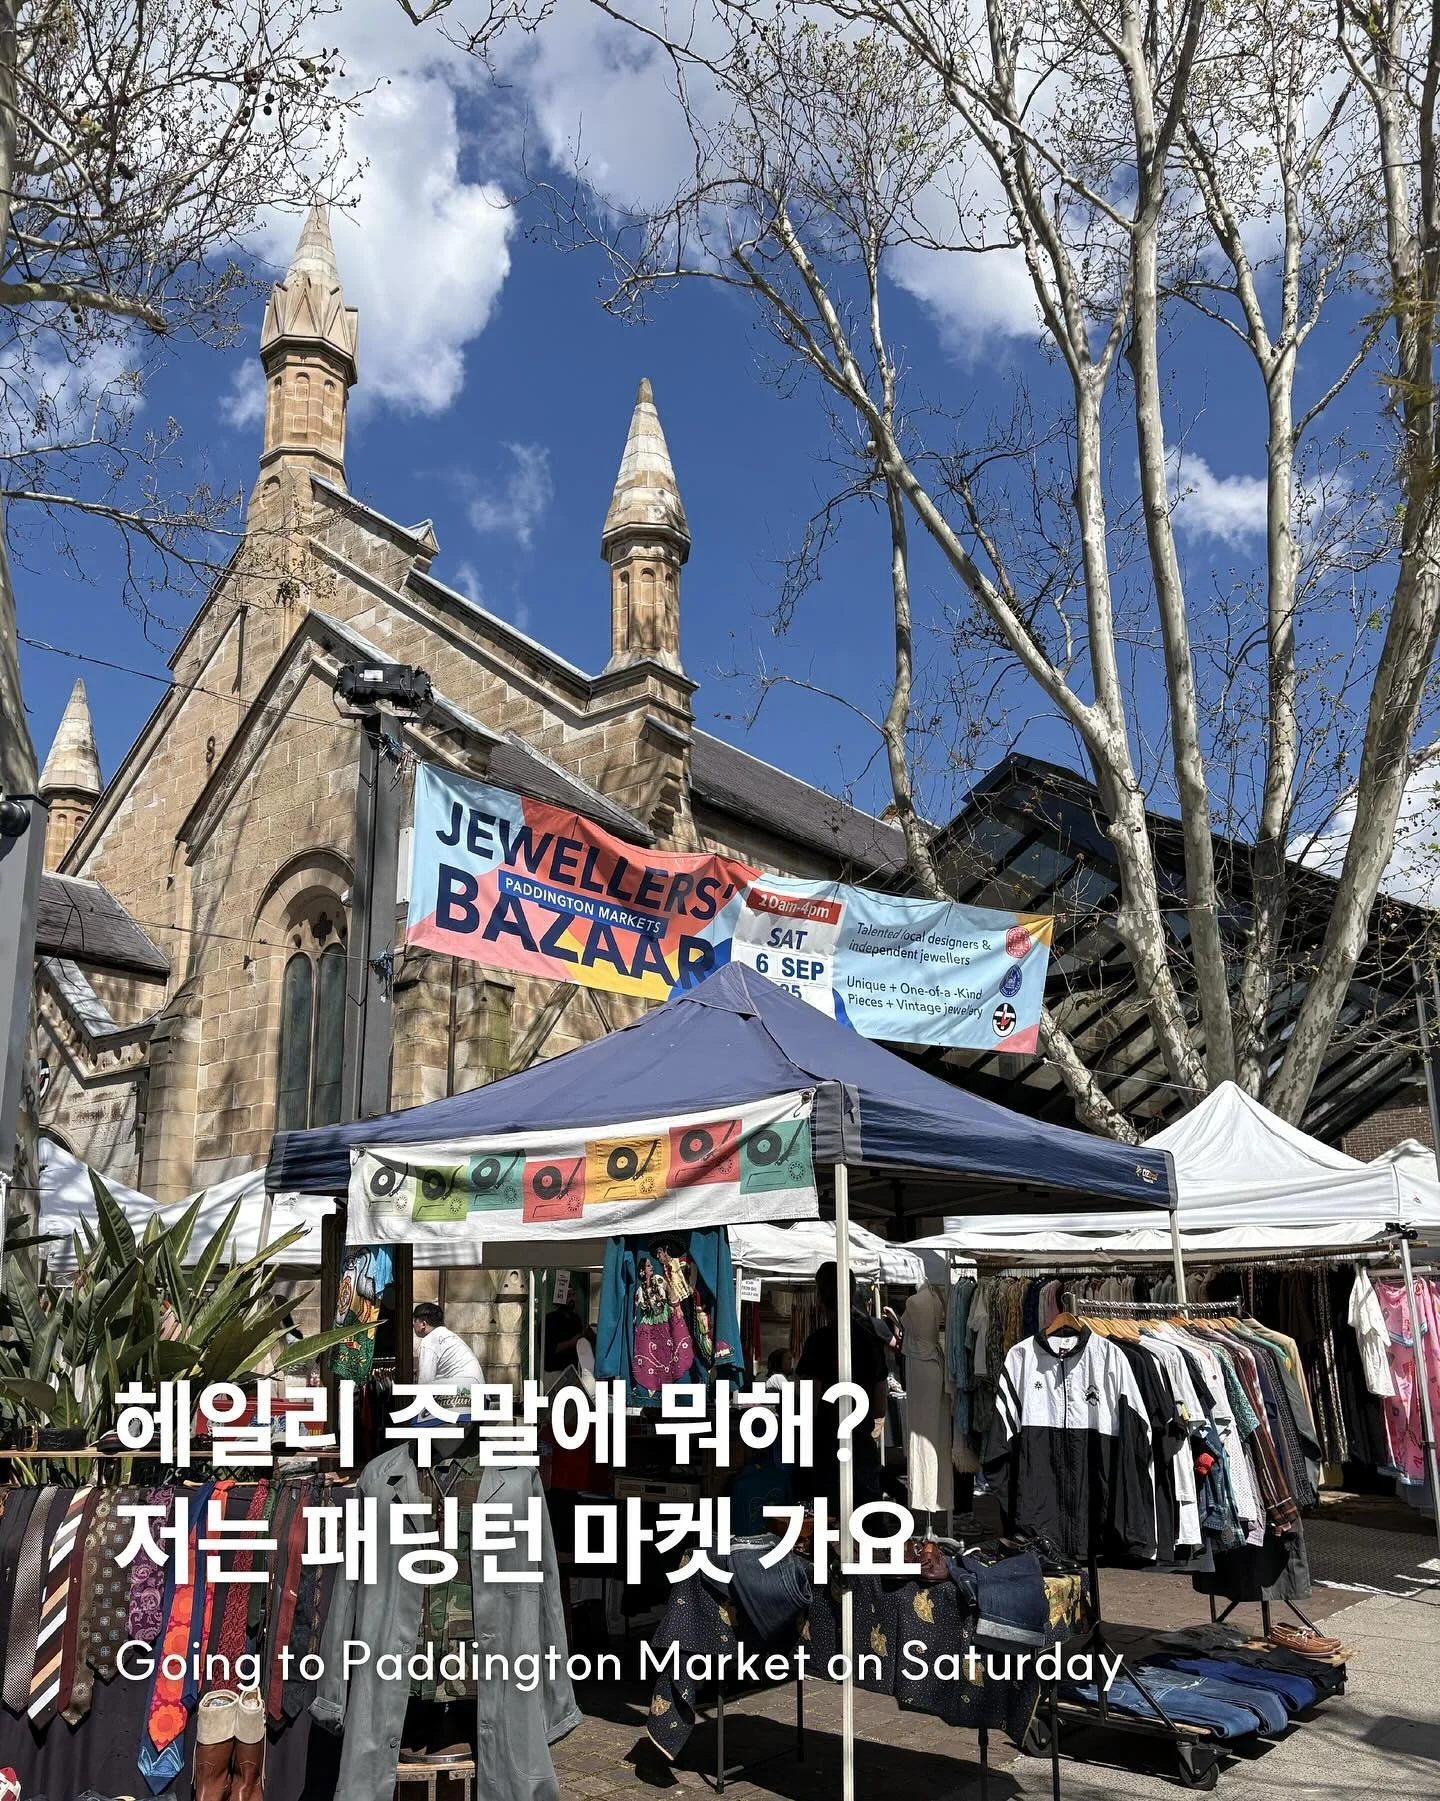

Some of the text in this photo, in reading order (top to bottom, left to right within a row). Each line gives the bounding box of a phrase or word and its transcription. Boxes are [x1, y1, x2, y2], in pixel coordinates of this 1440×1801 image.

[436, 801, 735, 920] JEWELLERS'
[505, 877, 661, 933] PADDINGTON MARKETS
[758, 893, 830, 918] 10am-4pm
[435, 863, 715, 989] BAZAAR
[767, 927, 808, 950] SAT
[857, 922, 901, 939] Talented
[900, 929, 925, 942] local
[927, 932, 979, 950] designers
[982, 940, 992, 950] &
[848, 939, 970, 966] independent jewellers
[756, 953, 824, 980] 6 SEP
[847, 975, 886, 993] Unique
[848, 993, 883, 1008] Pieces
[896, 998, 941, 1015] Vintage
